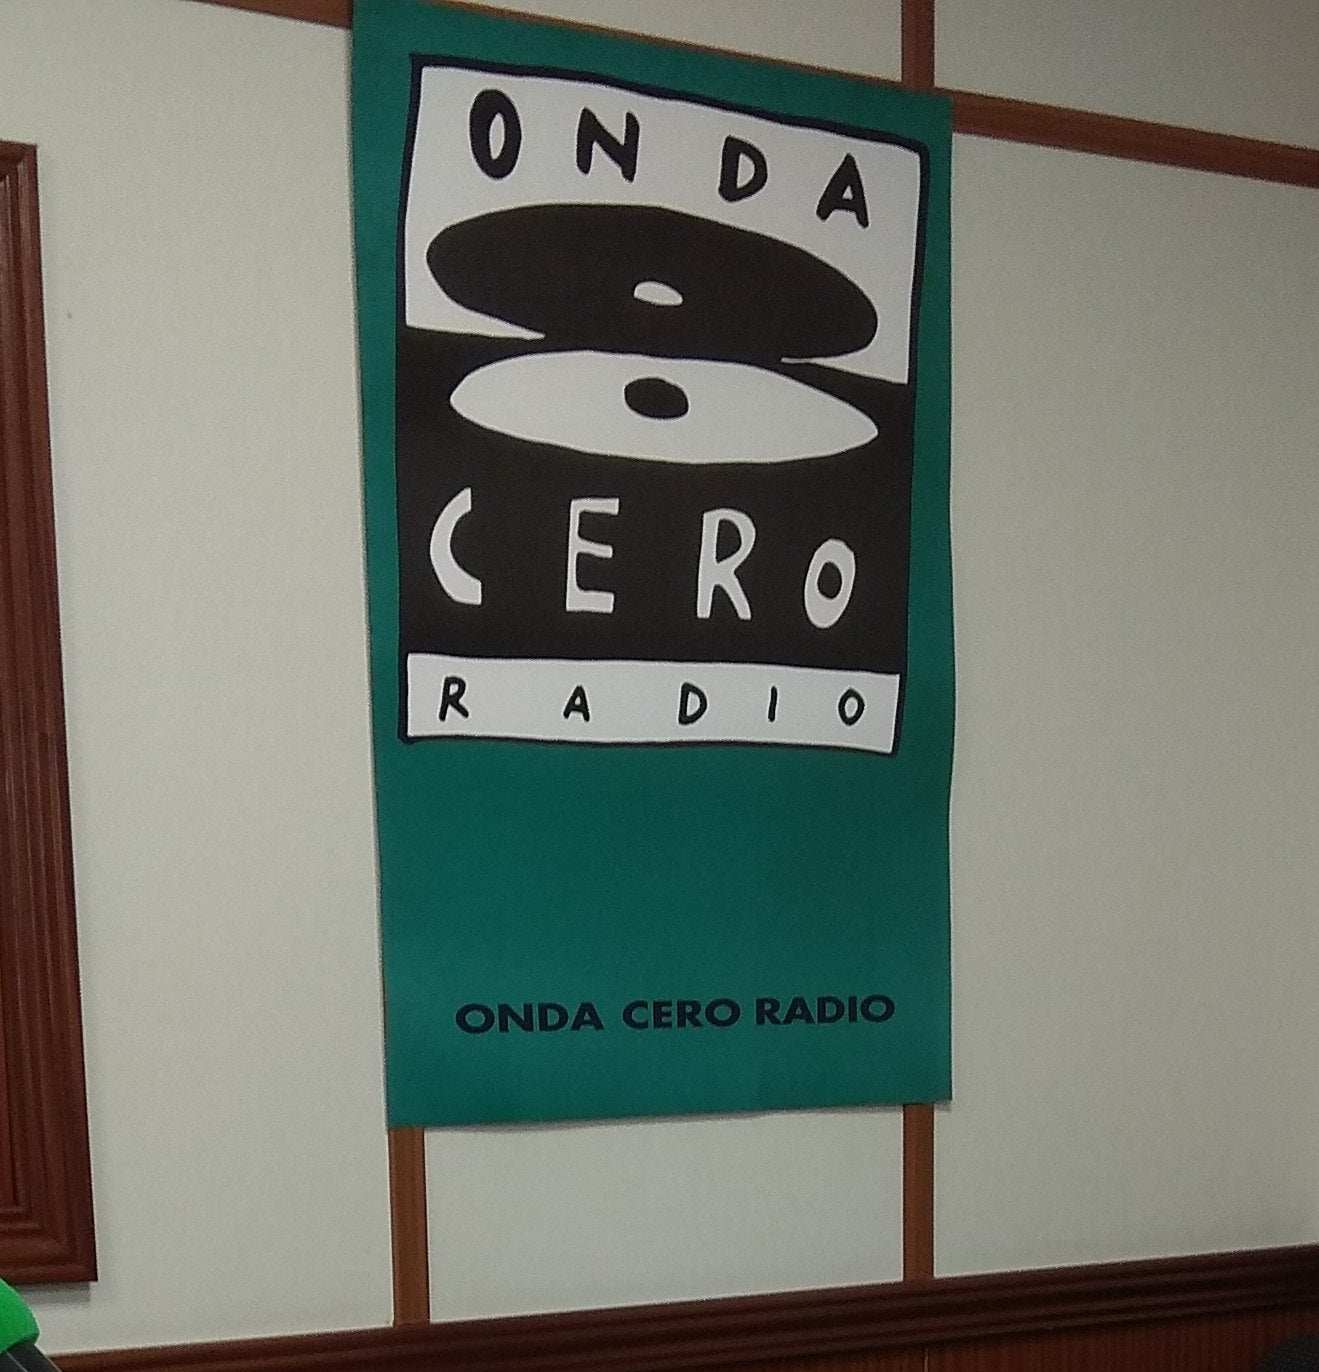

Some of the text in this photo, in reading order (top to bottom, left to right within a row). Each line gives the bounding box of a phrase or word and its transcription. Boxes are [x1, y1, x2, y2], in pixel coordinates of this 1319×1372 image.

[468, 88, 870, 228] ONDA
[430, 487, 856, 629] CERO
[438, 675, 866, 727] RADIO
[454, 993, 897, 1036] ONDA CERO RADIO
